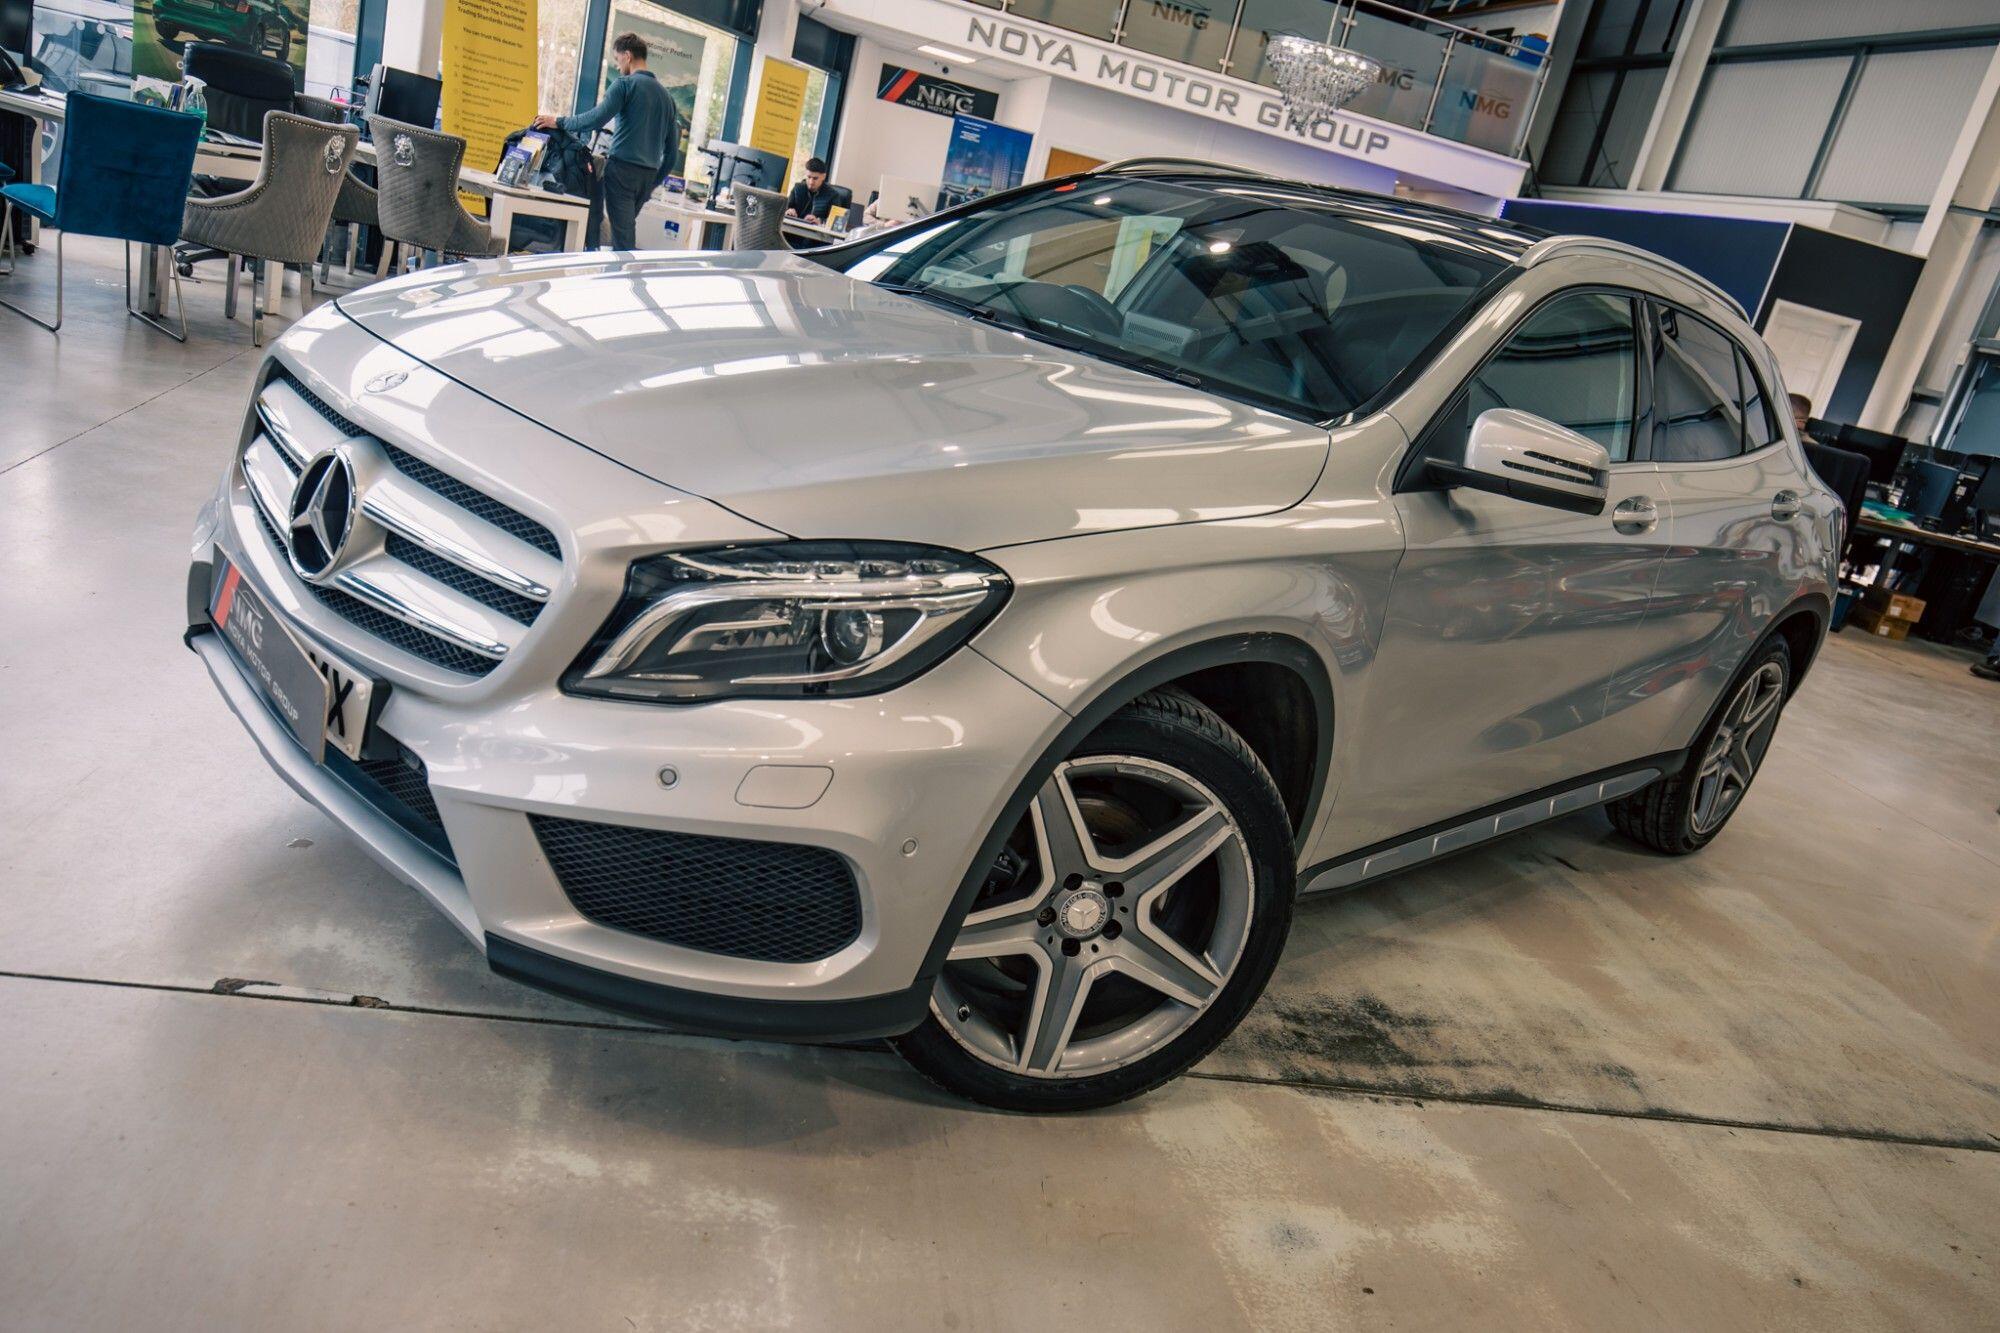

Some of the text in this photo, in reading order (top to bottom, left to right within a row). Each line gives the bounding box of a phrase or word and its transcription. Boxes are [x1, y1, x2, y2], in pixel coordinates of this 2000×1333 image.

[457, 6, 477, 18] Trading
[477, 12, 503, 25] Standards
[1152, 0, 1209, 30] NMG
[967, 17, 1077, 71] NOYA
[1097, 54, 1241, 117] MOTOR
[1377, 66, 1416, 91] MG
[905, 98, 954, 116] NOYA MOTOR
[917, 84, 974, 114] NMG
[1458, 91, 1511, 119] NMG
[230, 587, 264, 650] NMG
[246, 643, 272, 686] MOTOR
[272, 680, 299, 721] GROUP
